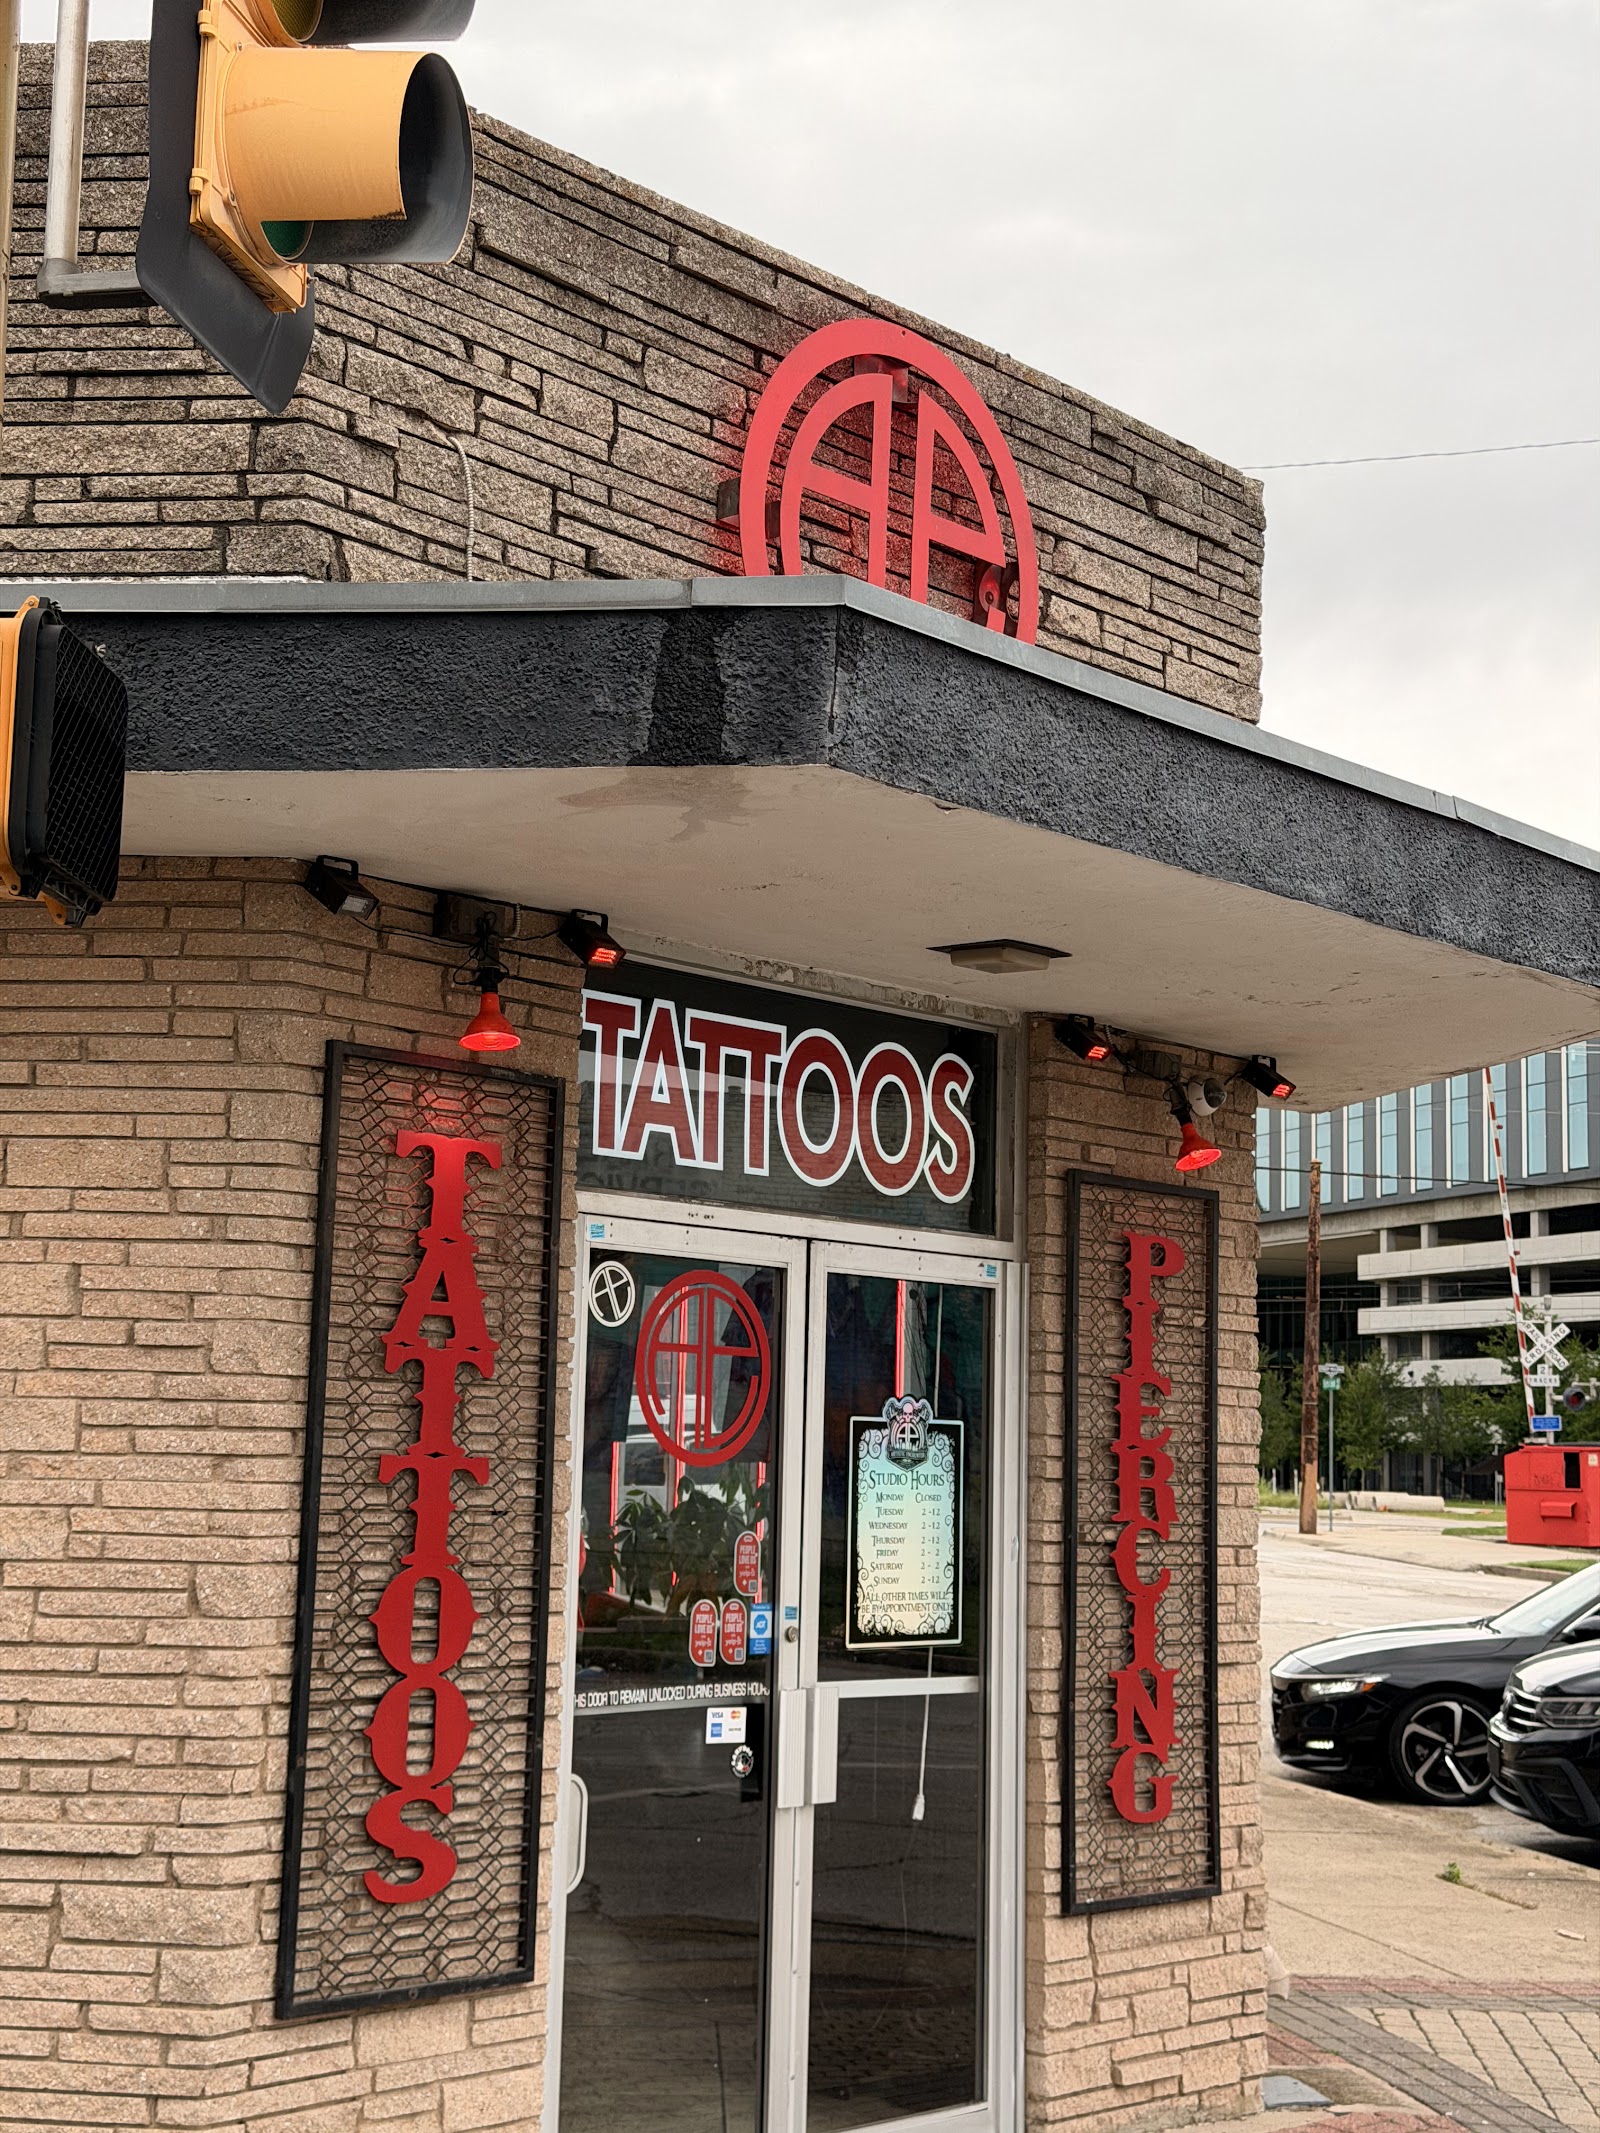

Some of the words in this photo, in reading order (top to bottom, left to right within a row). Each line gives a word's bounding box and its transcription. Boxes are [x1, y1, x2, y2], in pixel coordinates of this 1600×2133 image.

[581, 988, 975, 1204] TATTOOS
[1524, 1327, 1566, 1364] CROSSING
[1540, 1366, 1545, 1374] 2
[868, 1470, 908, 1489] STUDIO
[910, 1470, 945, 1490] HOURS
[875, 1492, 905, 1503] MONDAY
[915, 1492, 942, 1503] CLOSED
[362, 1128, 504, 1904] TATTOOS
[875, 1507, 905, 1518] TUESDAY
[868, 1521, 909, 1530] WEDNESDAY
[1106, 1230, 1186, 1824] PIERCING
[871, 1535, 906, 1547] THURSDAY
[876, 1549, 900, 1559] FRIDAY
[870, 1561, 904, 1573] SATURDAY
[873, 1576, 900, 1587] SUNDAY
[881, 1592, 907, 1601] OTHER
[908, 1591, 929, 1600] TIMES
[930, 1591, 947, 1600] WILL
[861, 1604, 870, 1613] BE
[871, 1603, 881, 1613] BY
[881, 1603, 931, 1613] APPOINTMENT
[932, 1602, 950, 1612] ONLY
[573, 1692, 586, 1708] HIS
[588, 1691, 608, 1707] DOOR
[609, 1690, 619, 1705] TO
[620, 1688, 648, 1705] REMAIN
[649, 1685, 685, 1702] UNLOCKED
[686, 1683, 713, 1700] DURING
[714, 1682, 747, 1698] BUSINESS
[711, 1711, 724, 1719] VISA
